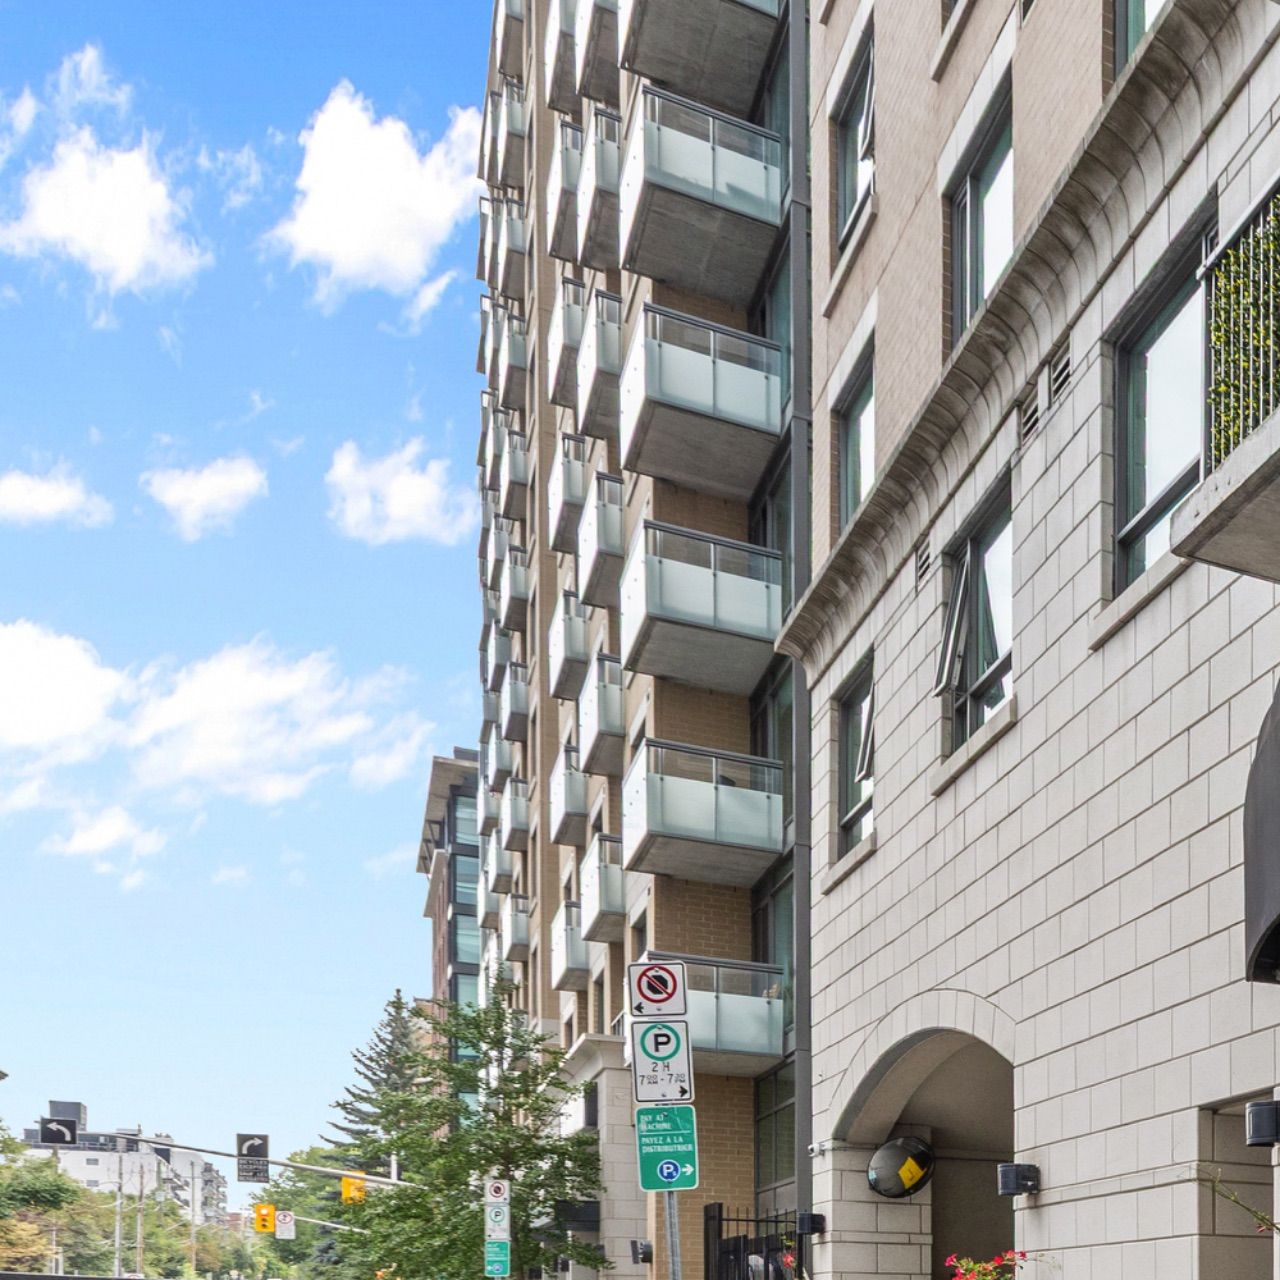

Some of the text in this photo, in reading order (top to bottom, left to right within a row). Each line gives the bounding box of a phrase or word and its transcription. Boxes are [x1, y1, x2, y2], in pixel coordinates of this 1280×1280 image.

[654, 1033, 671, 1052] P
[652, 1062, 670, 1073] 2 H
